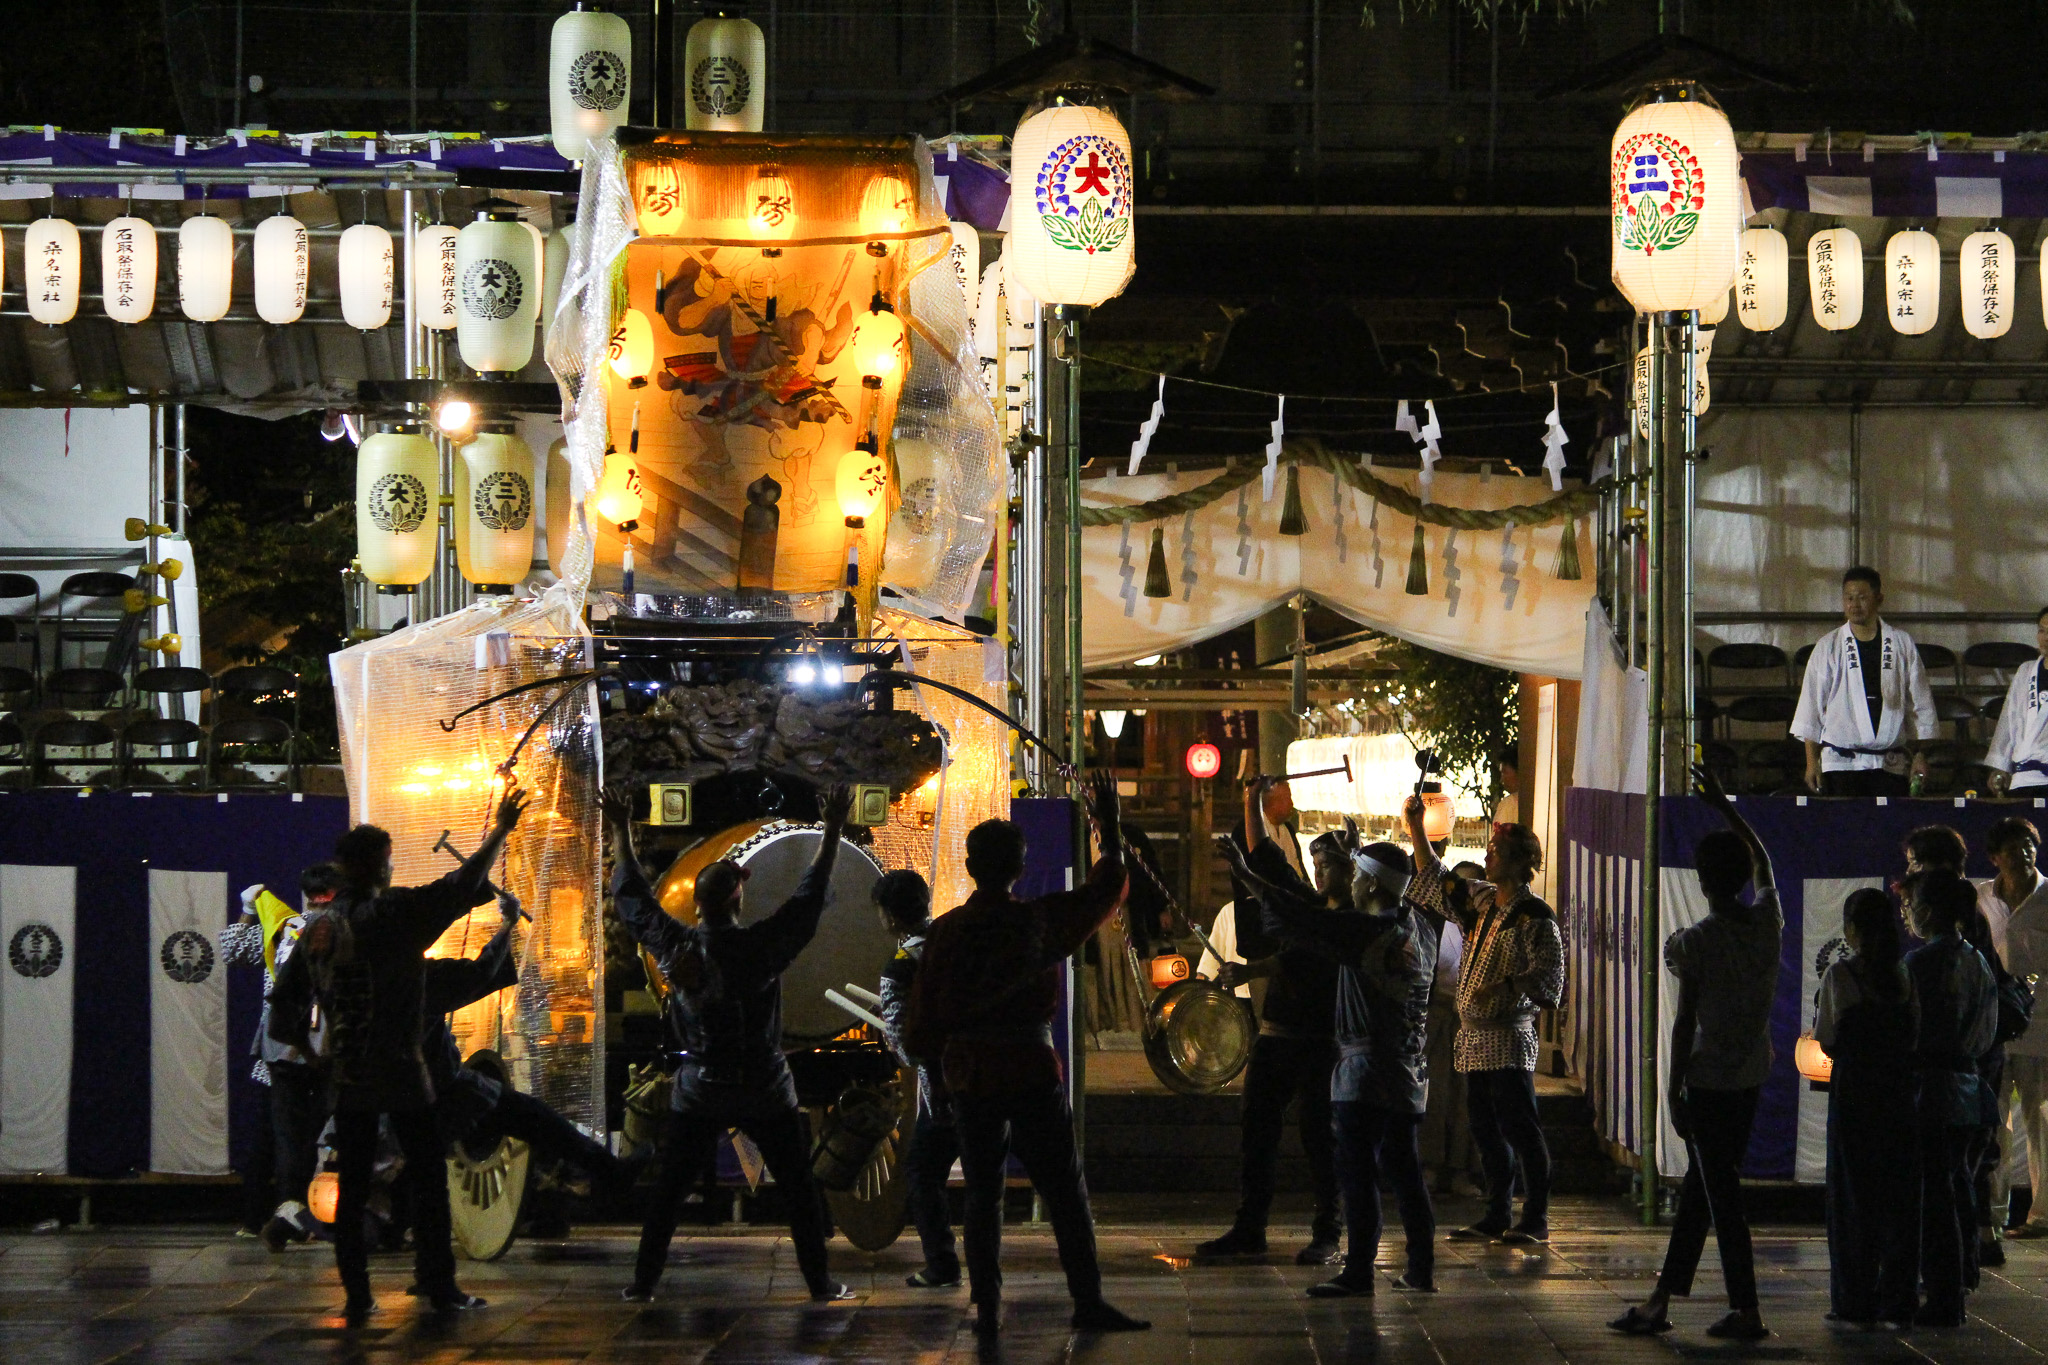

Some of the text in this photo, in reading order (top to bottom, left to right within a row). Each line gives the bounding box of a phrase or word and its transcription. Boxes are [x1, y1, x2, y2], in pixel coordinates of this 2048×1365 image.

[591, 58, 612, 81] 大
[709, 67, 731, 85] 三
[1072, 151, 1111, 197] 大
[1628, 154, 1669, 194] 三
[115, 228, 134, 307] 石取祭保存会
[440, 236, 456, 315] 石取祭保存会
[480, 267, 502, 289] 大
[1815, 238, 1838, 314] 石取祭保存会
[1981, 243, 2000, 324] 石取祭保存会
[387, 481, 410, 503] 大
[495, 481, 517, 500] 三
